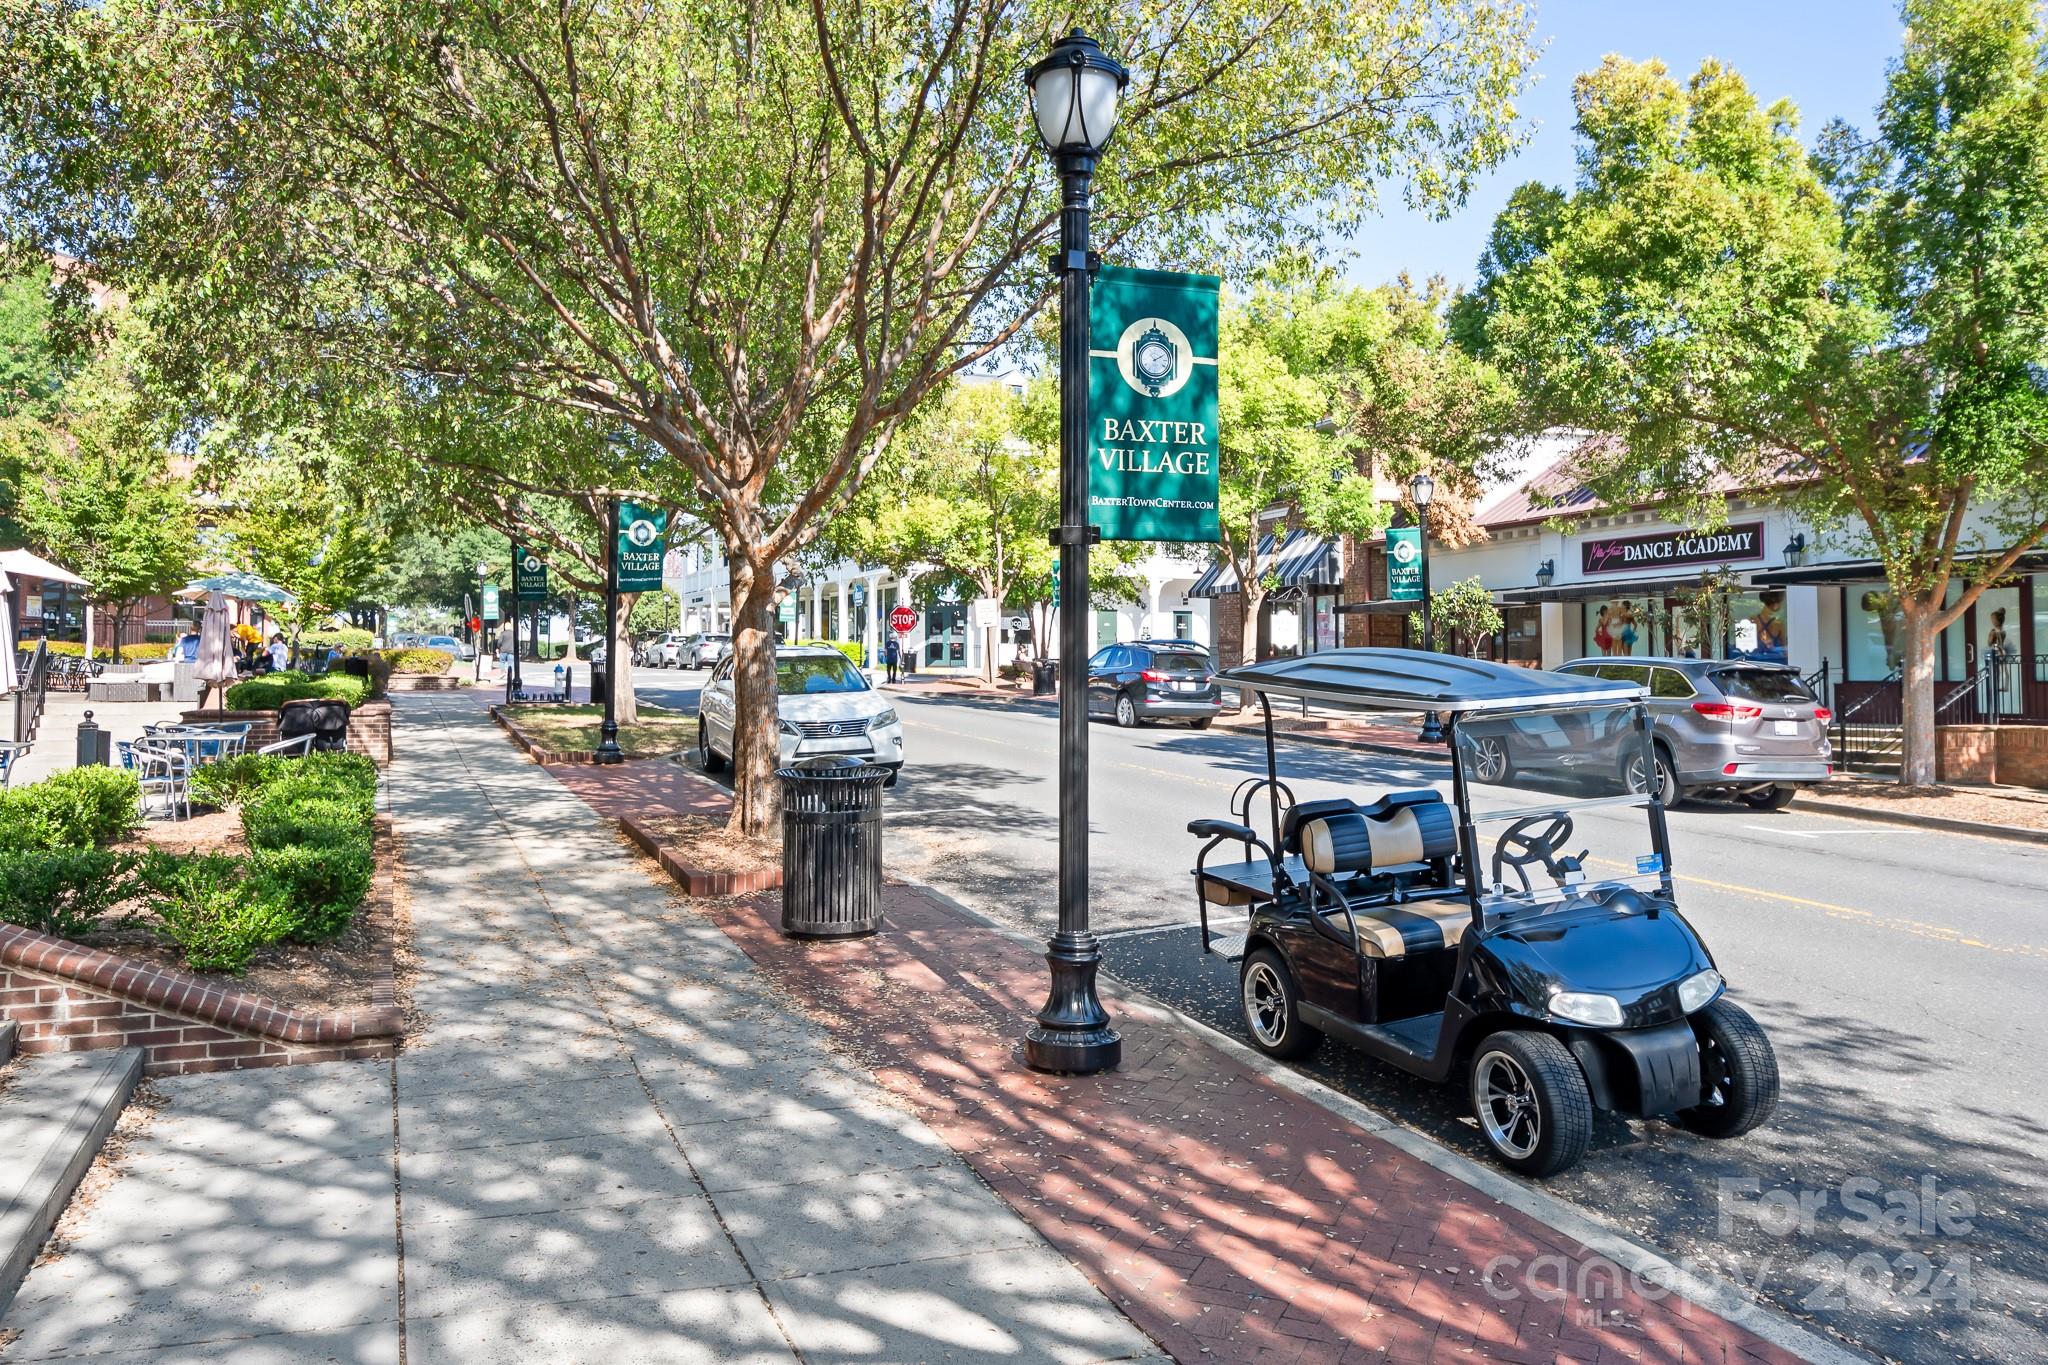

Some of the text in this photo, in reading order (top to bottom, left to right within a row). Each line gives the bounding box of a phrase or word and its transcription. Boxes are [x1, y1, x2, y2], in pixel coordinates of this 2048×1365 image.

[1103, 417, 1207, 446] BAXTER
[1097, 447, 1210, 475] VILLAGE
[1623, 541, 1672, 561] DANCE
[1676, 532, 1752, 557] ACADEMY
[623, 552, 660, 561] BAXTER
[621, 562, 660, 571] VILLAGE
[1391, 567, 1419, 576] BAXTER
[1391, 575, 1421, 584] VILLAGE
[892, 614, 915, 625] STOP
